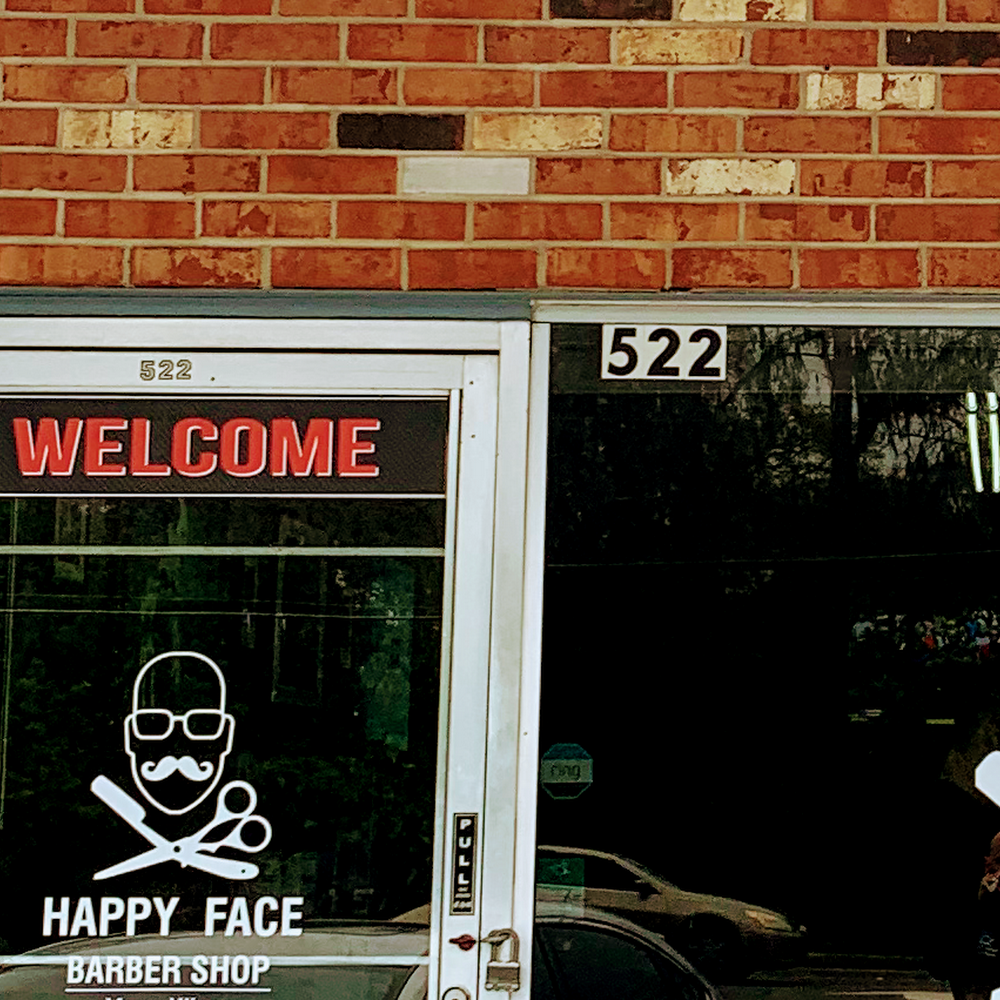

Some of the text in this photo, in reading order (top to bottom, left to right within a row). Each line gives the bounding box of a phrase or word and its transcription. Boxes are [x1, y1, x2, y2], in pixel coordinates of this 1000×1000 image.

[139, 359, 193, 381] 522
[608, 327, 722, 377] 522
[13, 417, 381, 478] WELCOME
[457, 818, 473, 885] PULL
[42, 896, 304, 937] HAPPY FACE
[66, 955, 271, 985] BARBER SHOP
